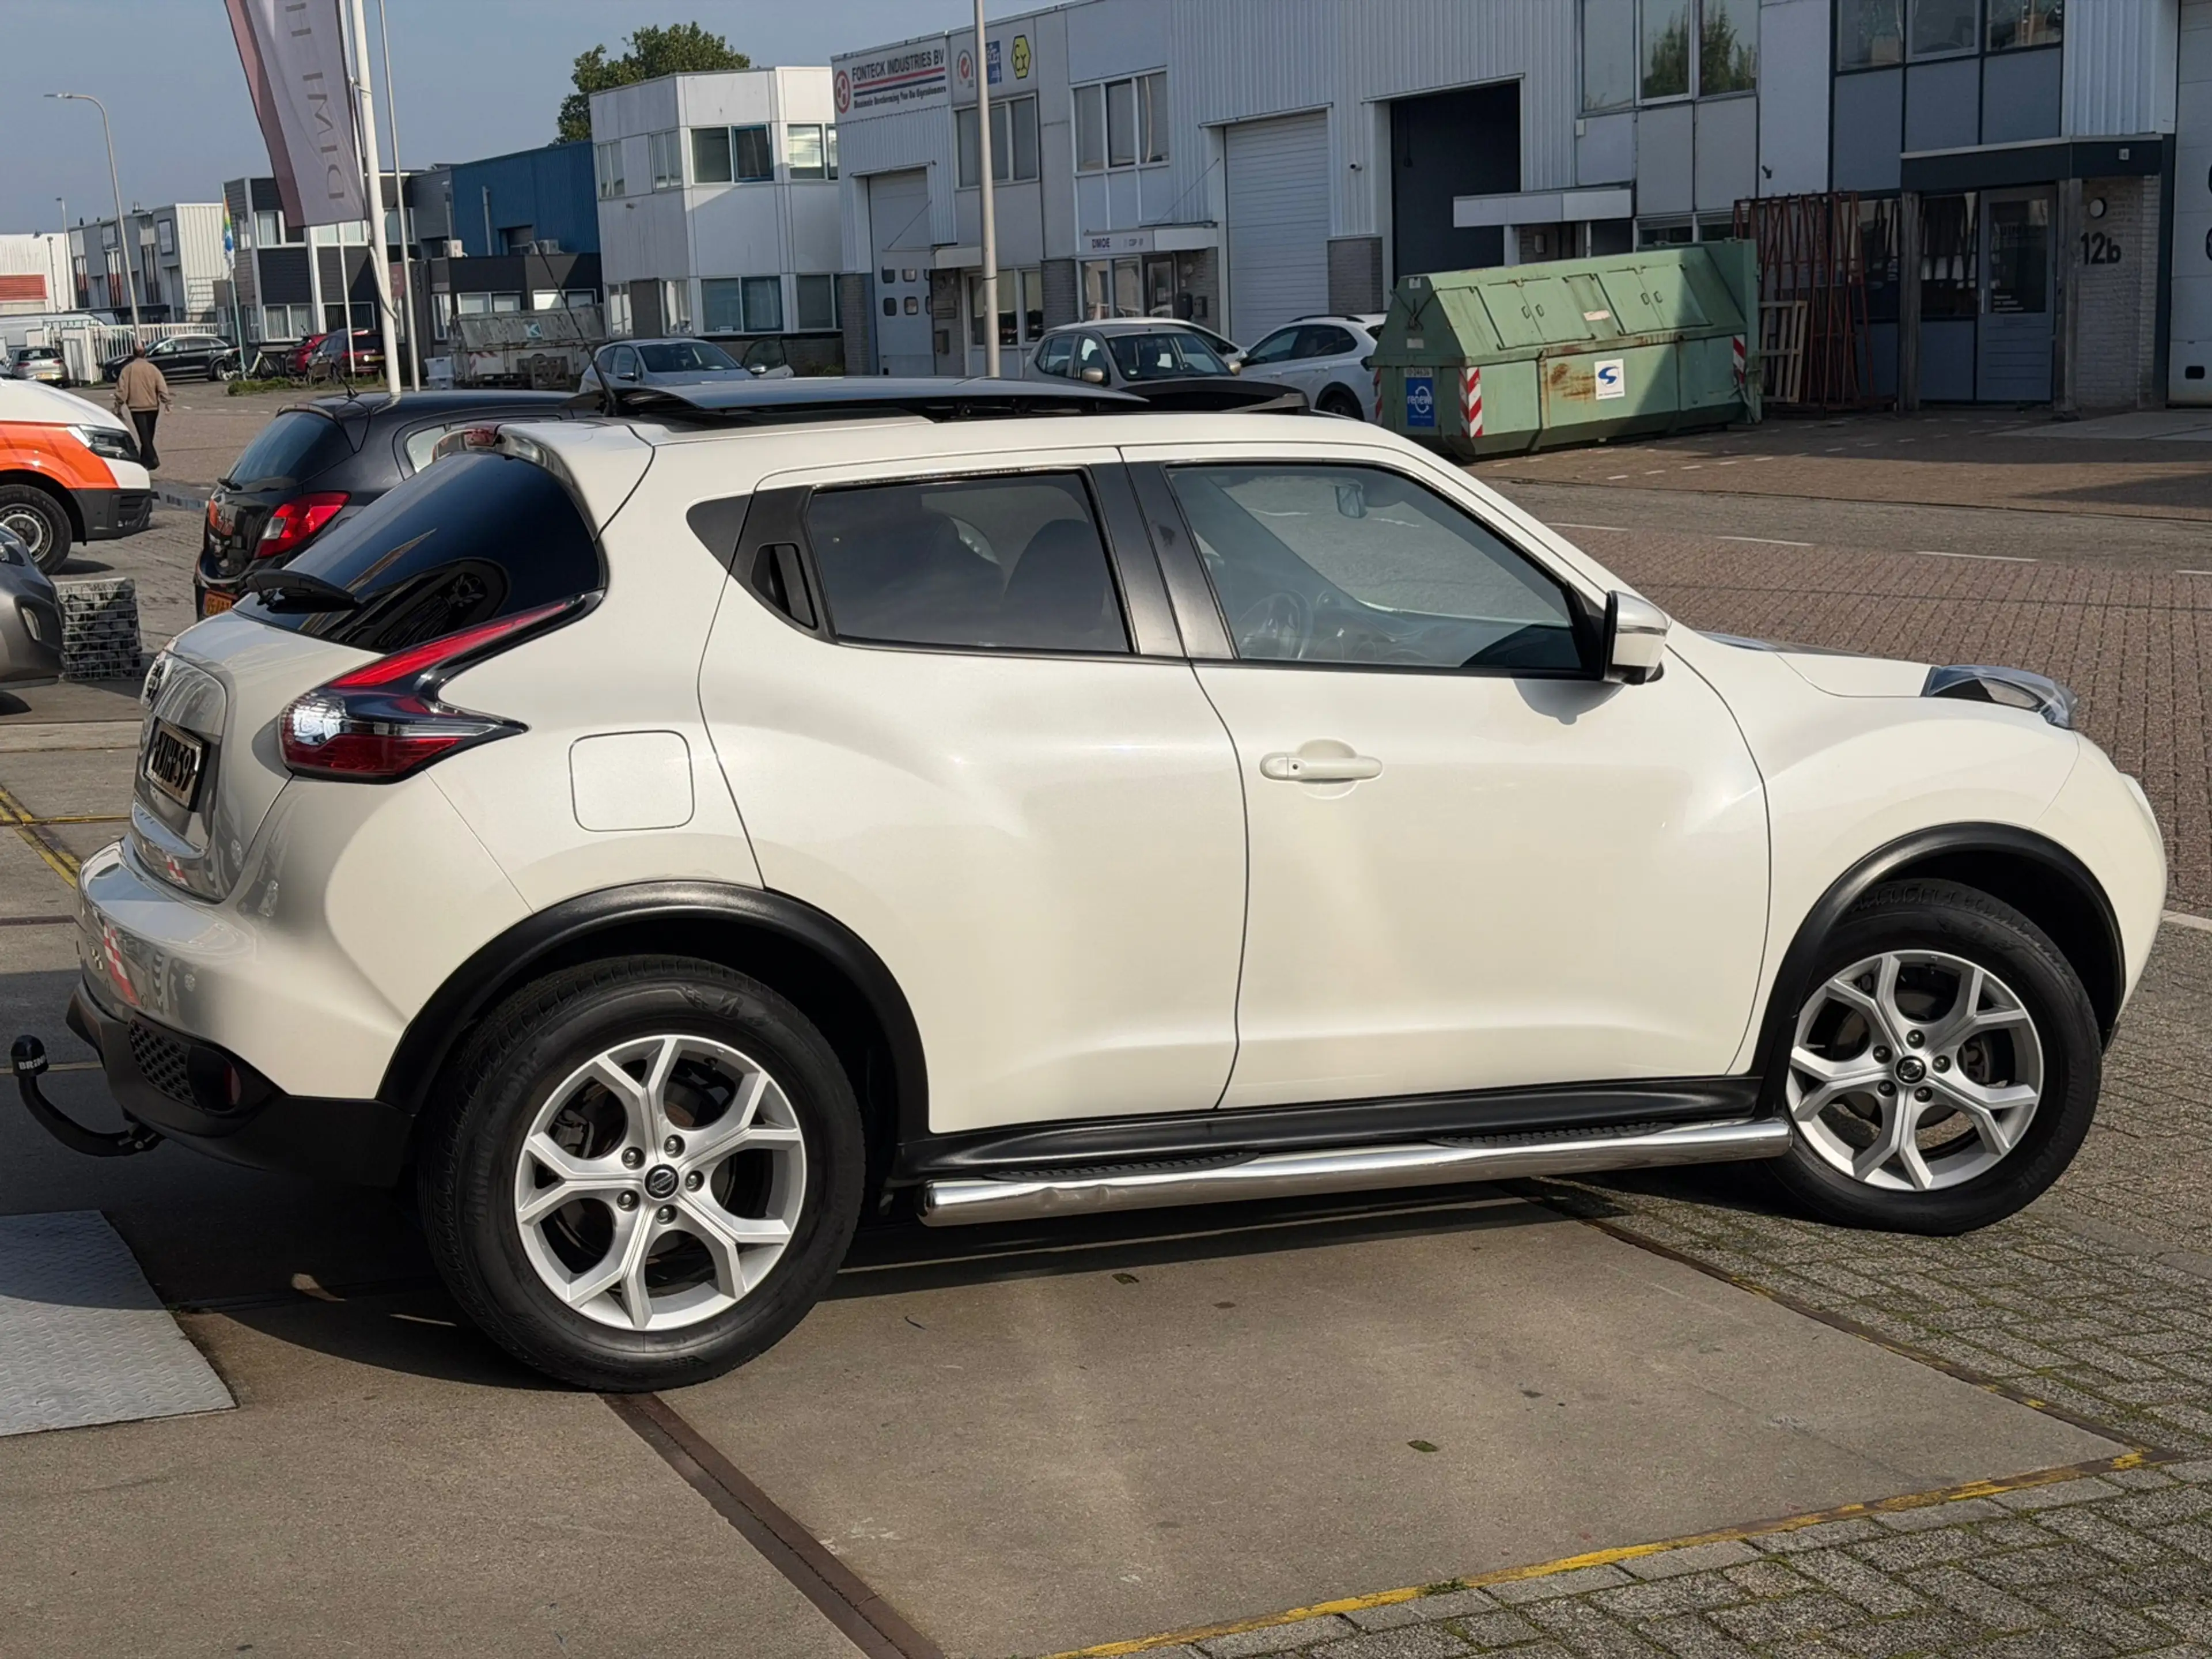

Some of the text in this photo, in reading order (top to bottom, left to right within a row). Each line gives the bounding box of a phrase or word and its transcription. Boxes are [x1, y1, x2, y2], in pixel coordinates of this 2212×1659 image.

[852, 48, 945, 82] FONTECK INDUSTRIES BV
[2080, 232, 2122, 265] 12b
